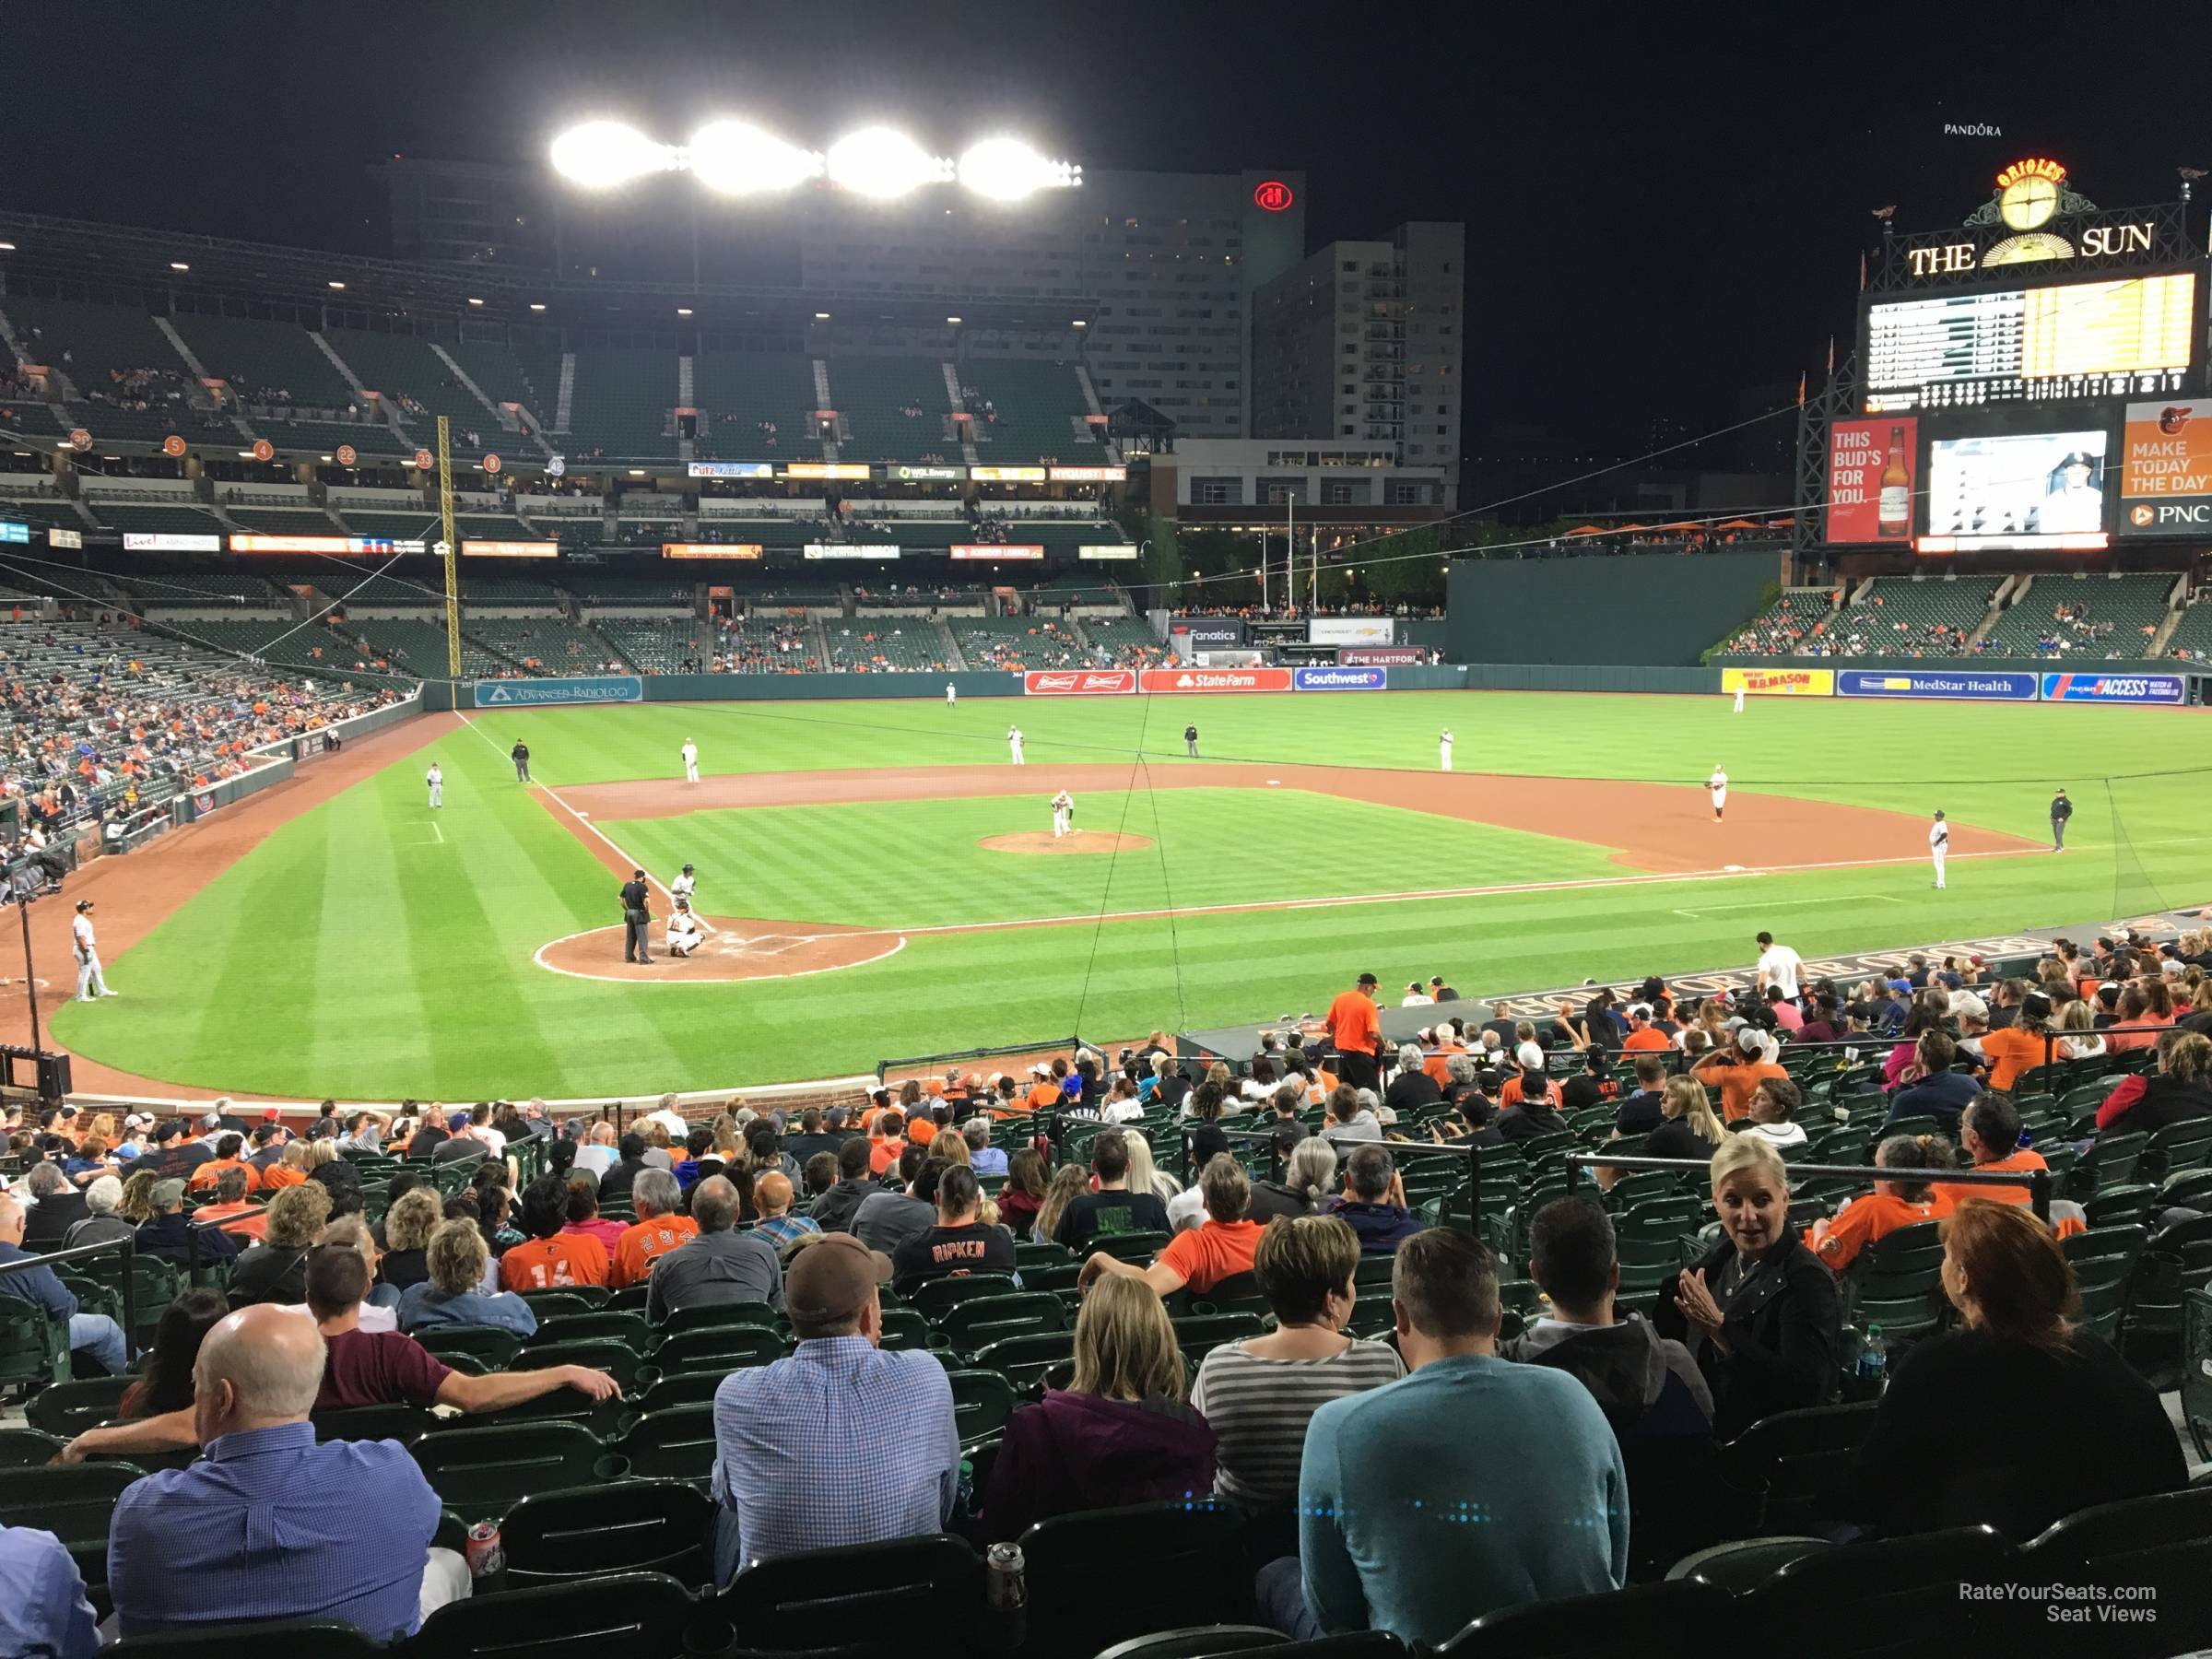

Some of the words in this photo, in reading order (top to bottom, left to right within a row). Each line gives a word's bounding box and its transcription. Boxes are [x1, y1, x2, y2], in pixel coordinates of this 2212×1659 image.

[1997, 158, 2065, 187] ORIOLES
[1910, 243, 1976, 276] THE
[2081, 223, 2154, 257] SUN
[2111, 379, 2125, 394] 2
[2140, 377, 2155, 393] 2
[2171, 374, 2181, 390] 1
[171, 441, 179, 452] 5
[1835, 431, 1870, 449] THIS
[260, 446, 267, 456] 4
[339, 450, 353, 461] 22
[2133, 441, 2188, 458] MAKE
[418, 454, 430, 465] 33
[1834, 450, 1882, 467] BUD'S
[2131, 458, 2191, 475] TODAY
[550, 464, 562, 473] 42
[929, 468, 955, 478] Energy
[1833, 469, 1864, 486] FOR
[2131, 477, 2167, 492] THE
[2171, 475, 2208, 491] DAY
[1832, 488, 1867, 504] YOU.
[2158, 505, 2210, 524] PNC
[126, 534, 156, 547] Live!
[1190, 629, 1236, 641] Fanatics
[1304, 673, 1369, 685] Southwest
[1913, 678, 1964, 690] MedStar
[1968, 679, 2012, 691] Health
[2101, 679, 2148, 695] ACCESS
[514, 689, 570, 700] ADVANCED
[574, 686, 629, 698] RADIOLOGY
[932, 1241, 985, 1263] RIPKEN
